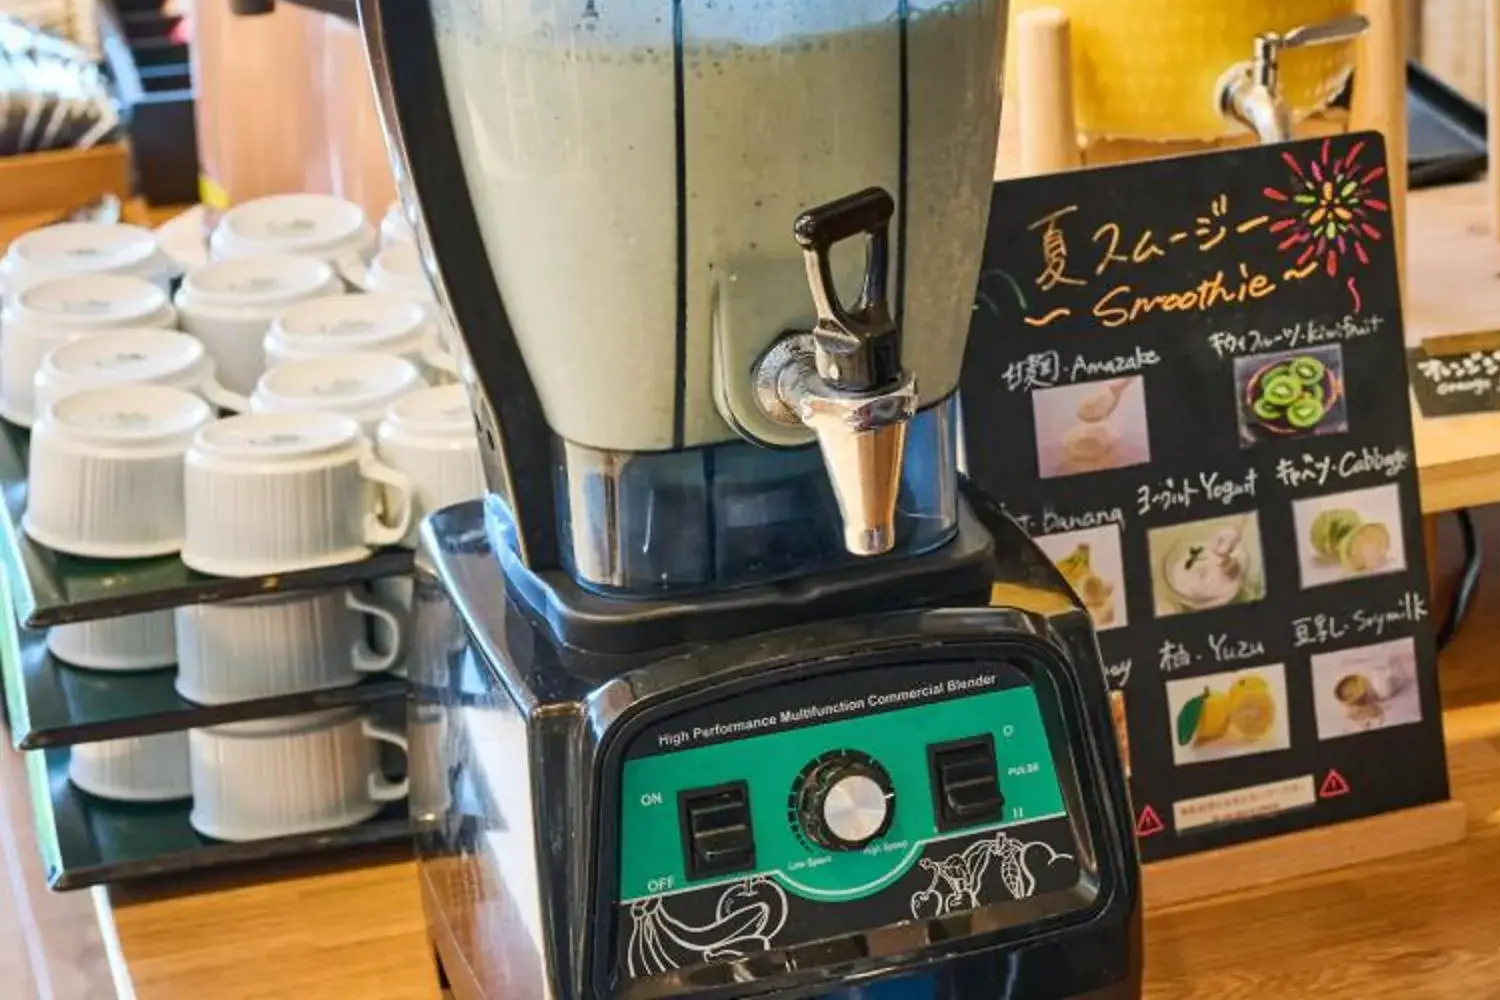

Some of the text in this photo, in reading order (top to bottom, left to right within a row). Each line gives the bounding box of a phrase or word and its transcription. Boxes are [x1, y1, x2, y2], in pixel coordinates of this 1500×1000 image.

[1092, 263, 1276, 327] Smoothie
[1071, 346, 1161, 382] Amazake
[1208, 634, 1265, 662] Yuzu
[658, 674, 997, 747] High Performance Multifunction Commercial Blender
[640, 792, 664, 807] ON
[647, 875, 675, 893] OFF
